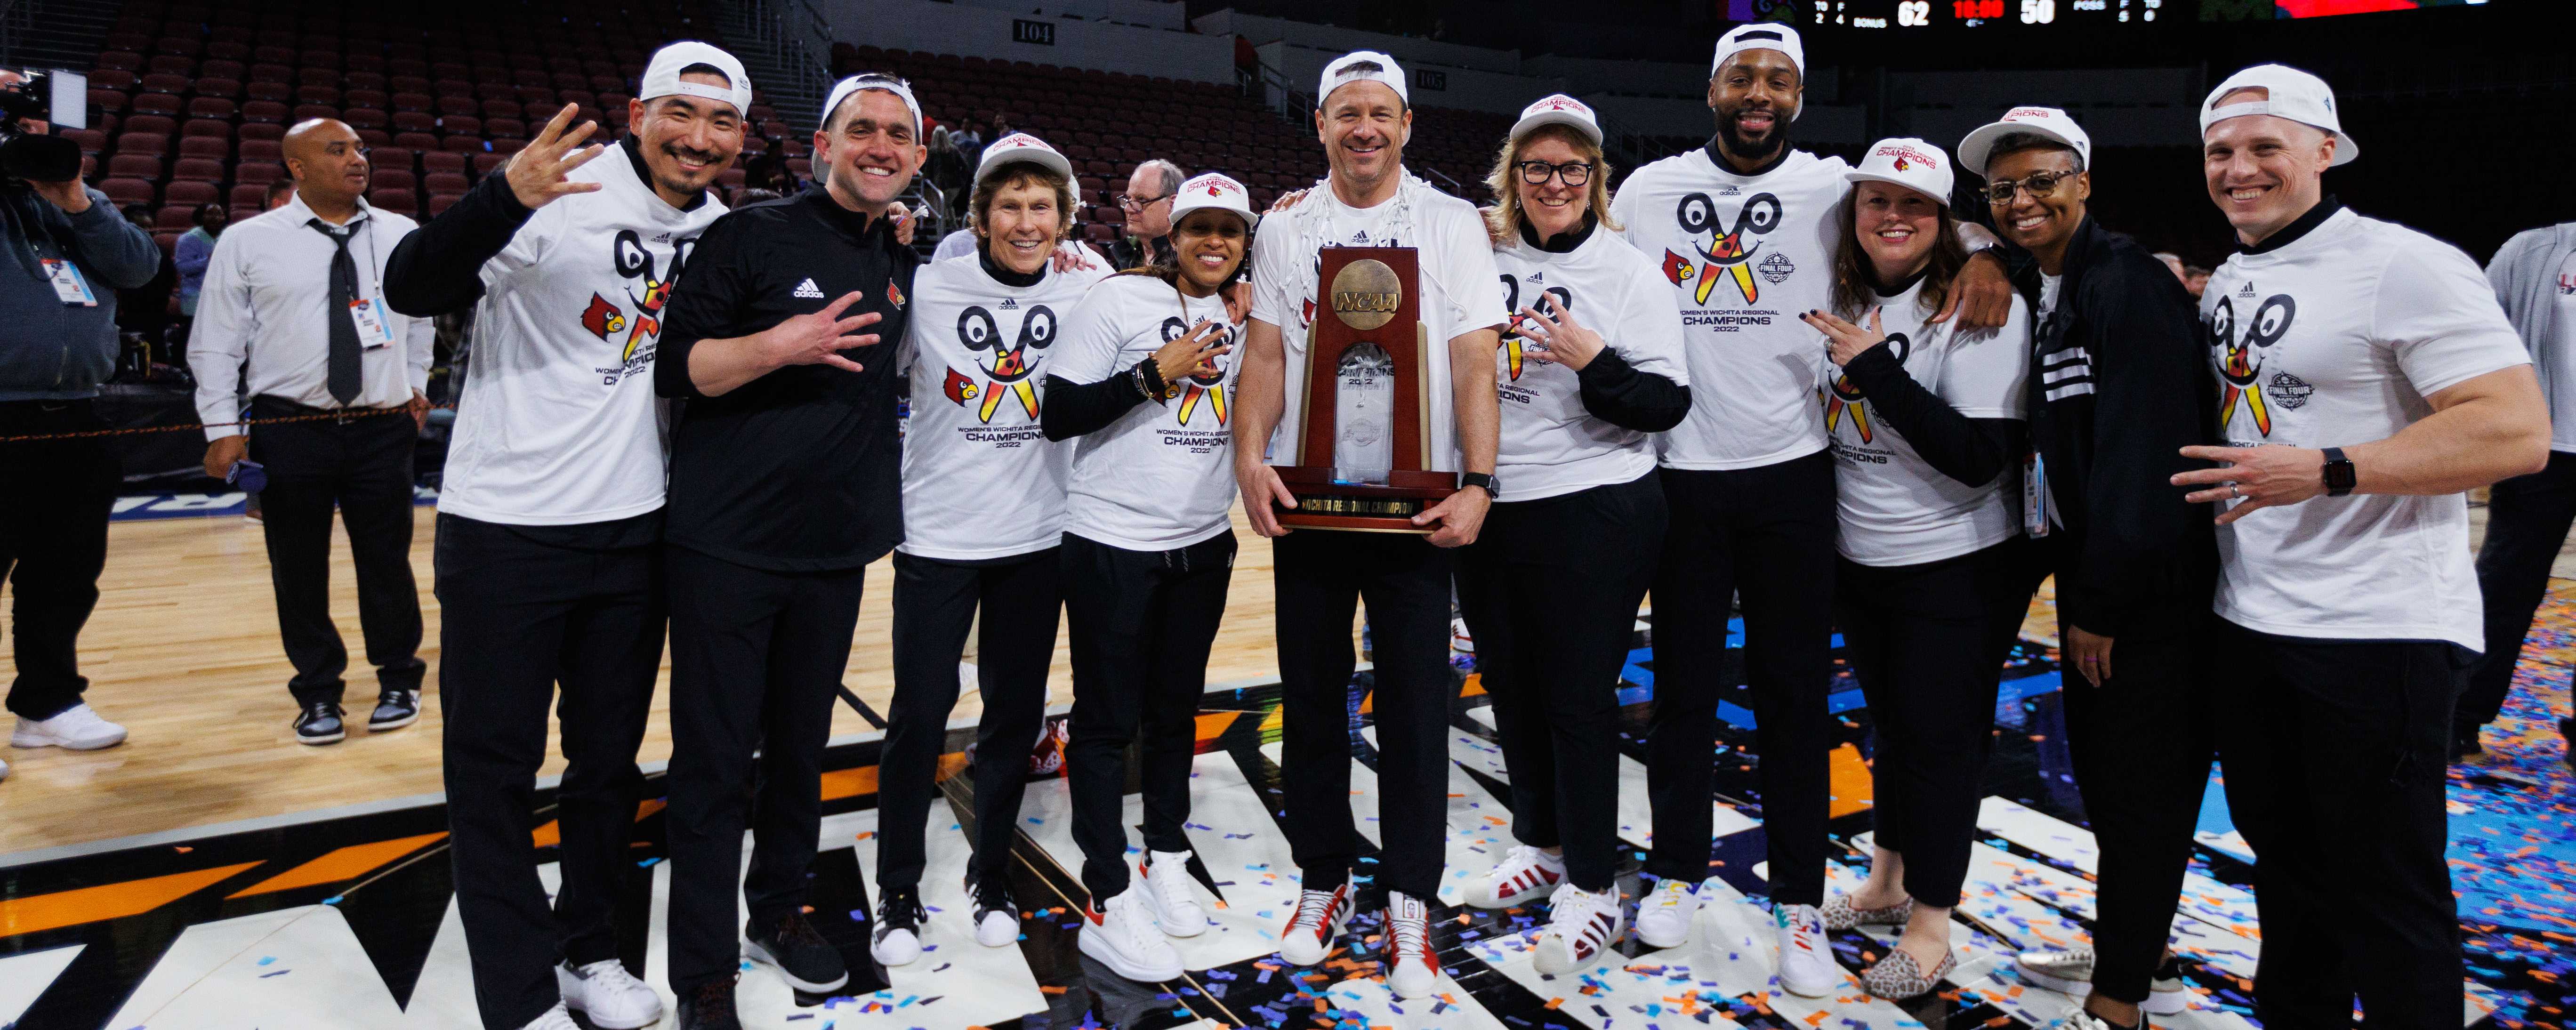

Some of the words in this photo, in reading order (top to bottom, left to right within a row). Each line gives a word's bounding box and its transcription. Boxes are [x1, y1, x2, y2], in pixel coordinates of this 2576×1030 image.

[1837, 2, 1844, 11] F
[2073, 0, 2107, 10] POSS
[1898, 1, 1929, 26] 62
[2021, 0, 2055, 24] 50
[1816, 13, 1824, 23] 2
[1836, 14, 1844, 24] 4
[1853, 17, 1887, 28] BONUS
[1020, 22, 1049, 42] 104
[1531, 100, 1586, 114] CHAMPIONS
[1876, 150, 1936, 169] CHAMPIONS
[1187, 181, 1241, 194] CHAMPIONS
[794, 290, 824, 298] adidas
[1336, 292, 1398, 313] NCAA
[1683, 316, 1771, 325] CHAMPIONS
[625, 366, 646, 378] 2022
[1505, 384, 1540, 396] REGIONAL
[2269, 386, 2287, 395] FINAL
[2288, 386, 2310, 395] FOUR
[1858, 447, 1897, 456] REGIONAL
[1302, 499, 1332, 511] WICHITA
[1333, 499, 1370, 513] REGIONAL
[1372, 501, 1413, 515] CHAMPION
